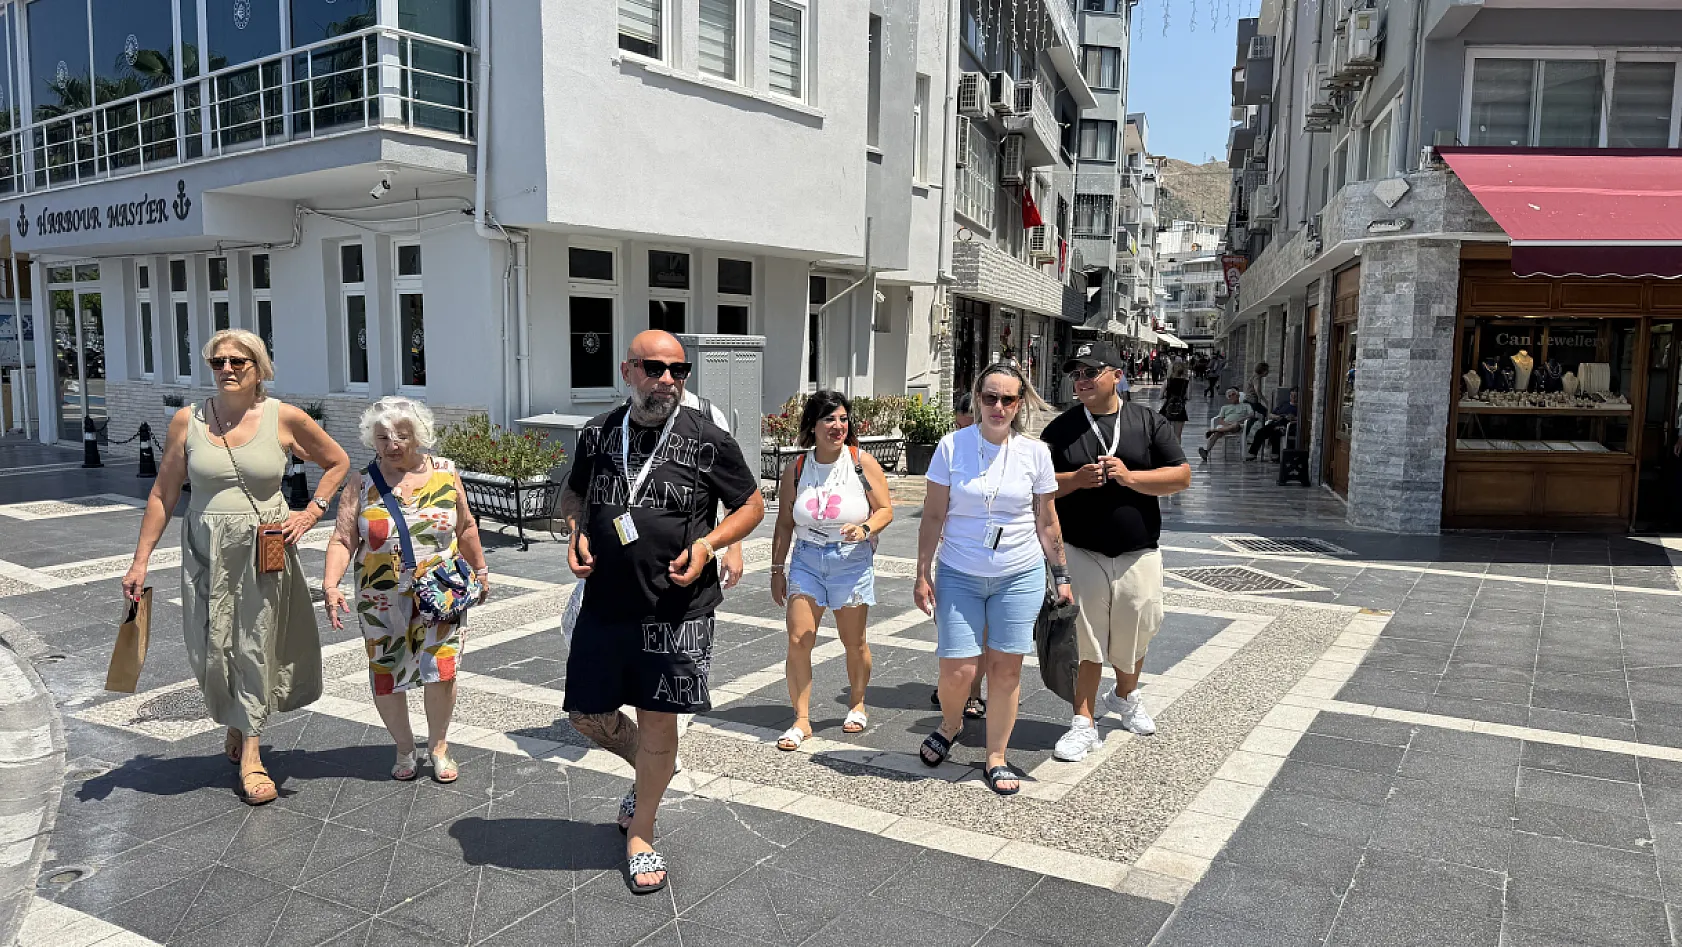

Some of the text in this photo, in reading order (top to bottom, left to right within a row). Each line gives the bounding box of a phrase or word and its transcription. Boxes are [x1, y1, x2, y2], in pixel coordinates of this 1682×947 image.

[37, 193, 169, 236] HARBOUR MASTER
[1495, 332, 1608, 348] Can Jewellery
